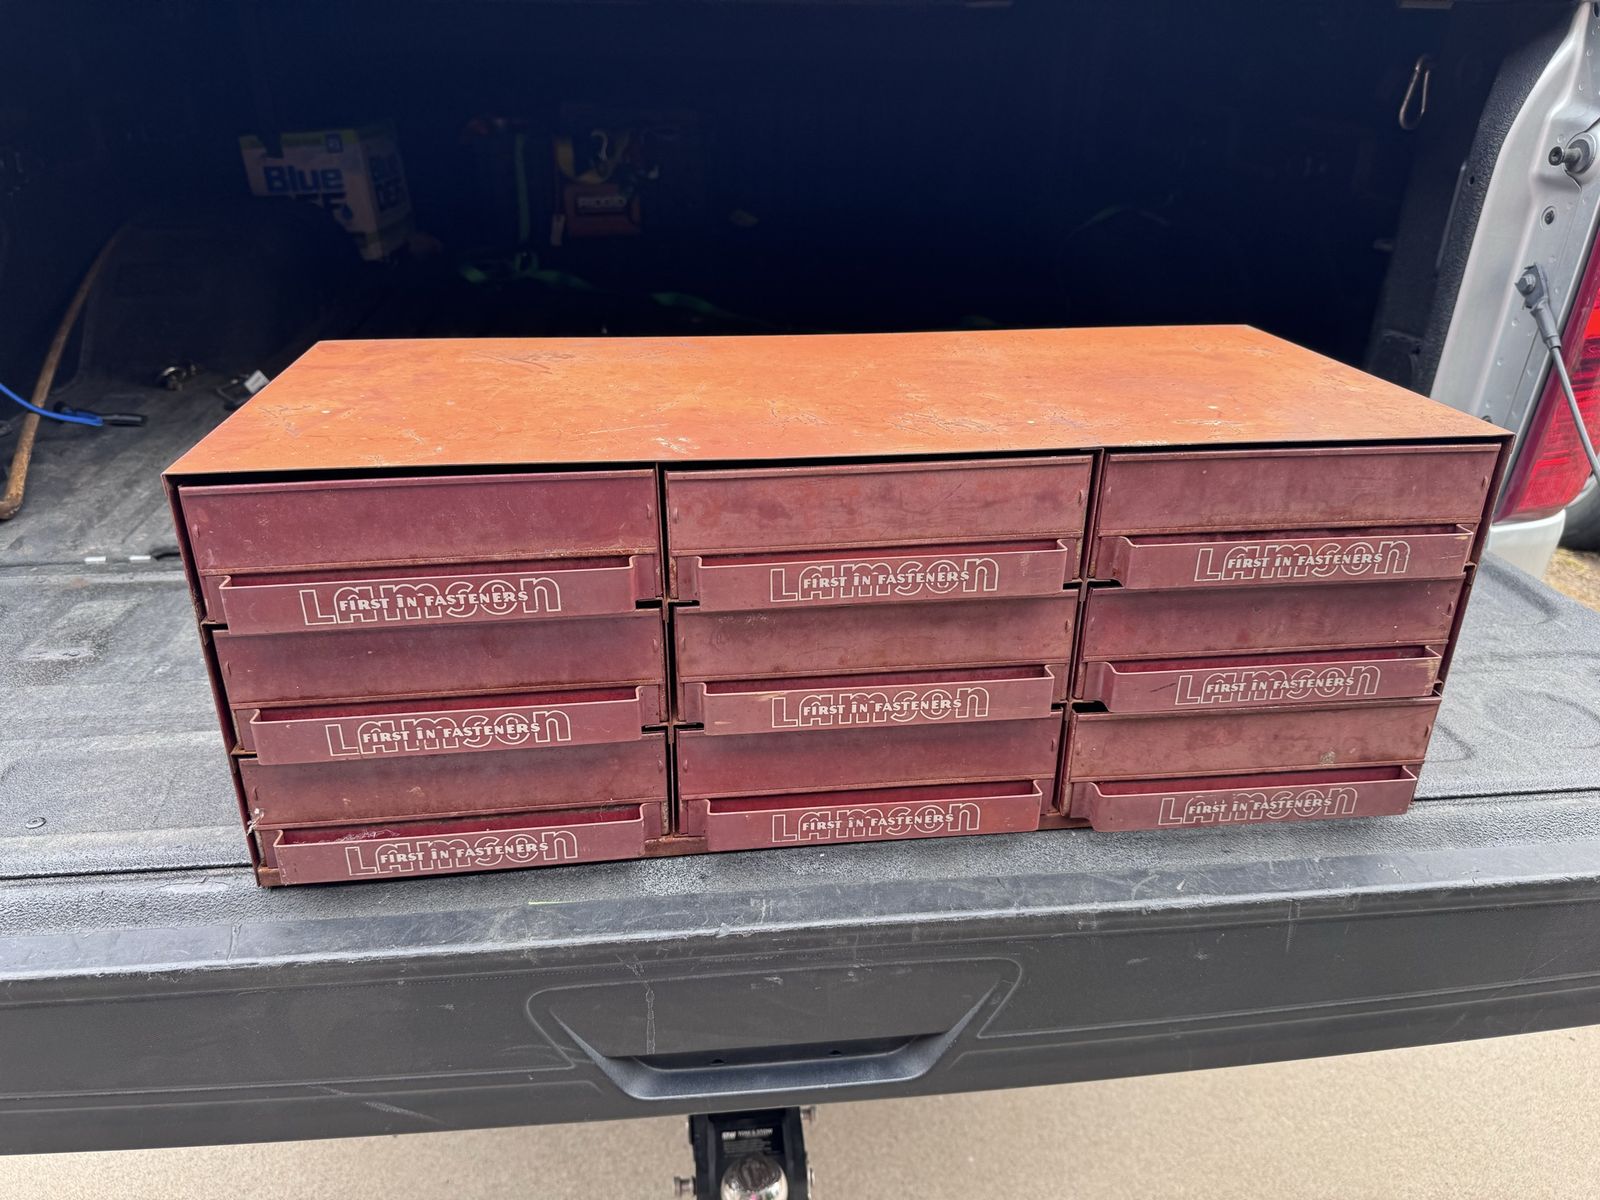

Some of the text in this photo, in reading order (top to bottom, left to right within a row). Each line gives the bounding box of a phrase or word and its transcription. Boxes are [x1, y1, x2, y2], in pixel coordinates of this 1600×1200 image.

[264, 165, 345, 192] Blue
[1227, 553, 1383, 568] FIRST IN FASTENERS
[803, 571, 970, 589] FIRST IN FASTENERS
[339, 591, 529, 611] FIRST IN FASTENERS
[1206, 677, 1354, 694] FIRST IN FASTENERS
[803, 699, 962, 716] FIRST IN FASTENERS
[362, 723, 541, 743] FIRST IN FASTENERS
[1188, 797, 1332, 814] FIRST IN FASTENERS
[802, 814, 955, 831] FIRST IN FASTENERS
[380, 843, 549, 864] FIRST IN FASTENERS
